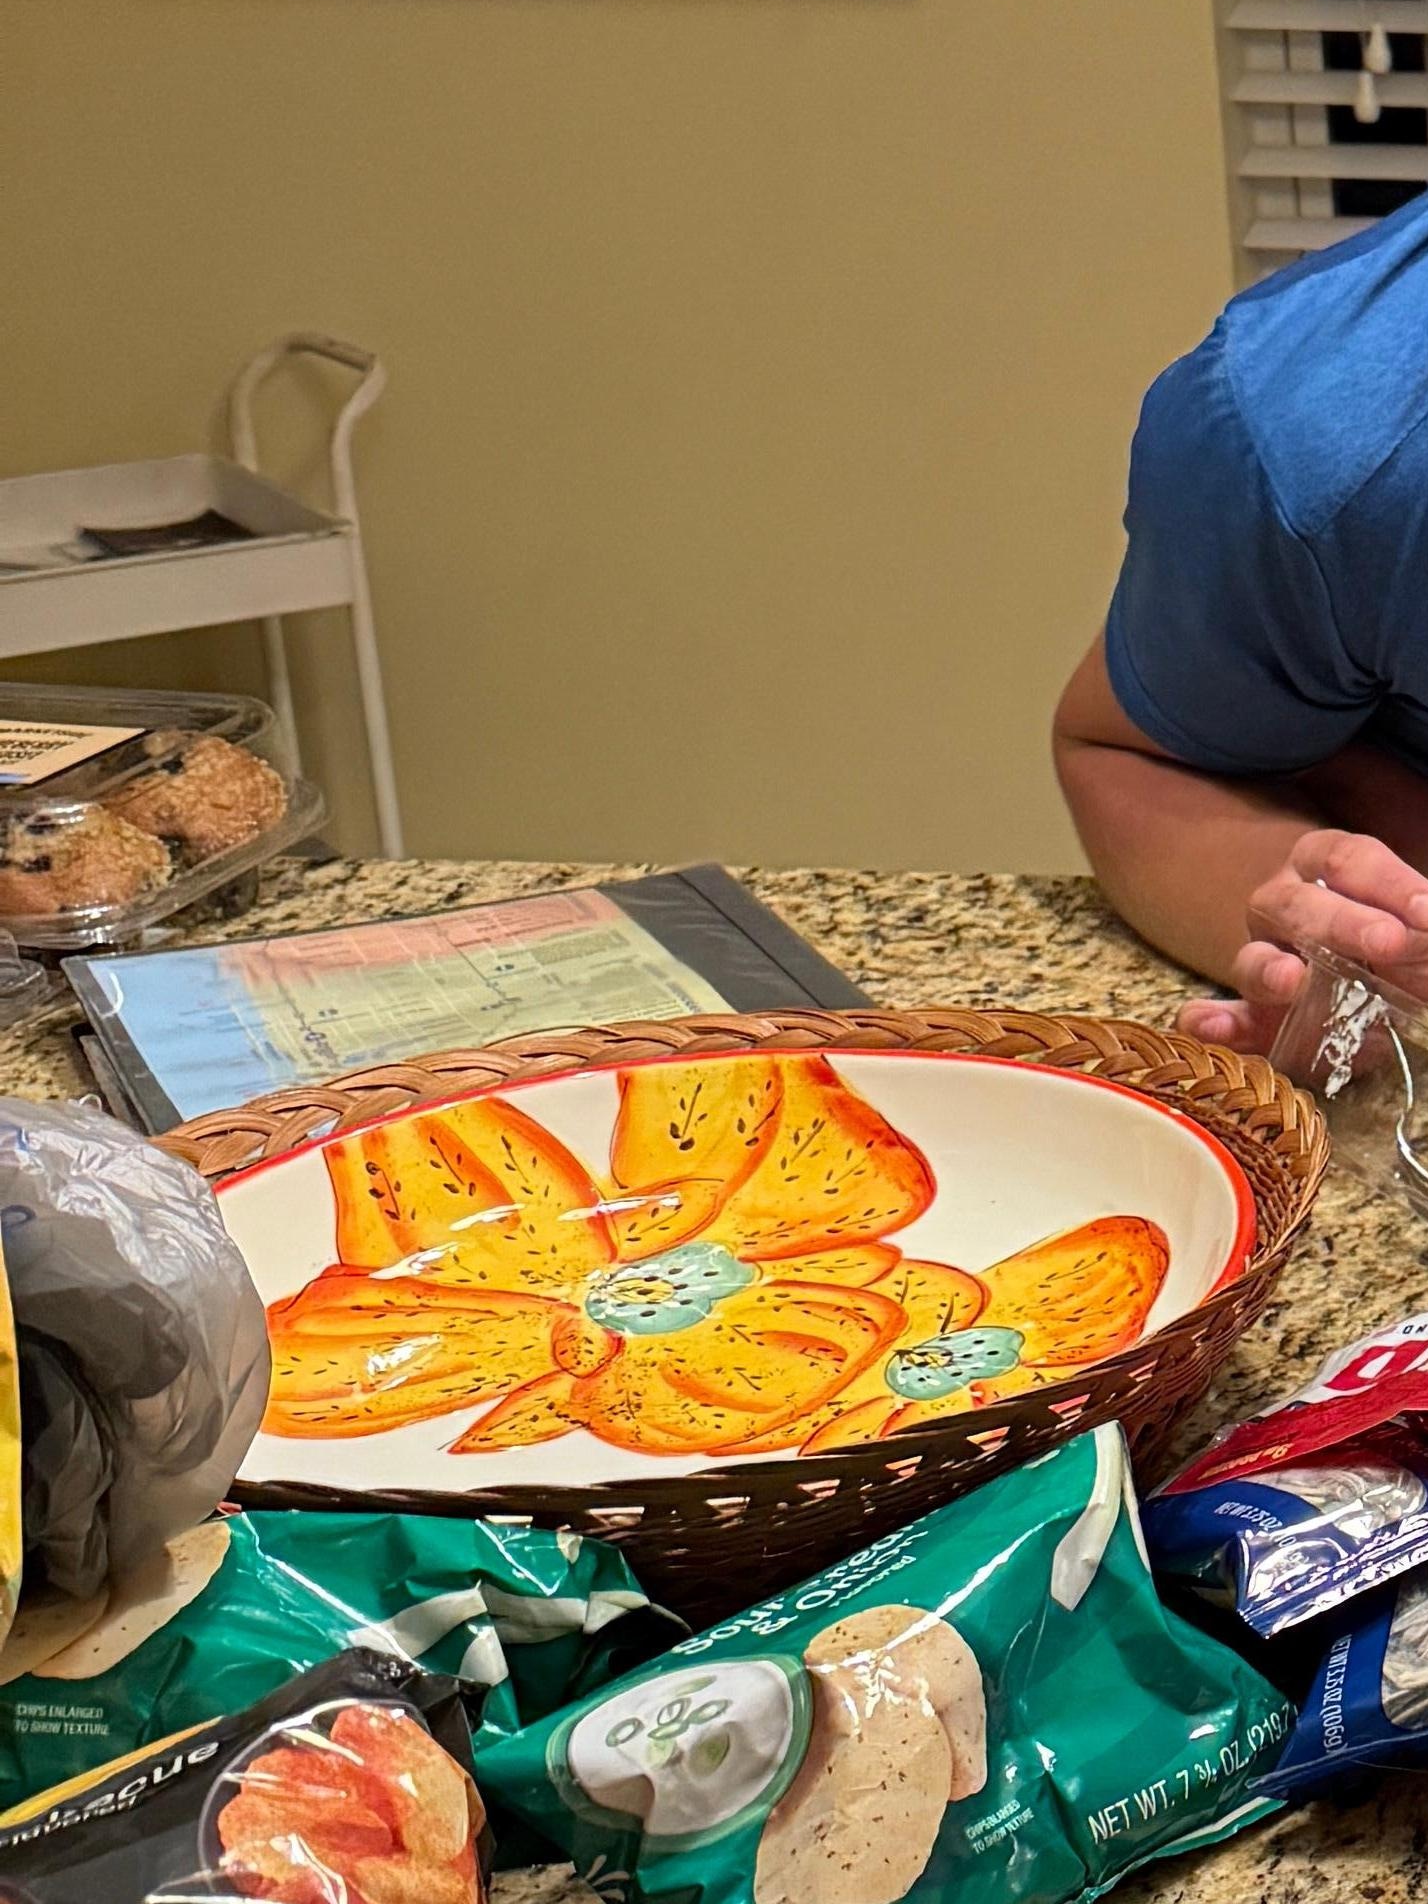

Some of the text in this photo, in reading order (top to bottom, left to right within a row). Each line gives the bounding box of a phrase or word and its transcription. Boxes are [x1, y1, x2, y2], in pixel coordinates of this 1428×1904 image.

[751, 1530, 930, 1636] & Onion
[669, 1595, 786, 1655] Sour
[15, 1721, 110, 1736] TO SHOW TEXTURE
[16, 1704, 104, 1720] CHIPS ENLARGED
[1088, 1798, 1131, 1845] NET
[1133, 1779, 1176, 1821] WT.
[1175, 1769, 1190, 1799] 7
[1219, 1740, 1250, 1777] OZ.
